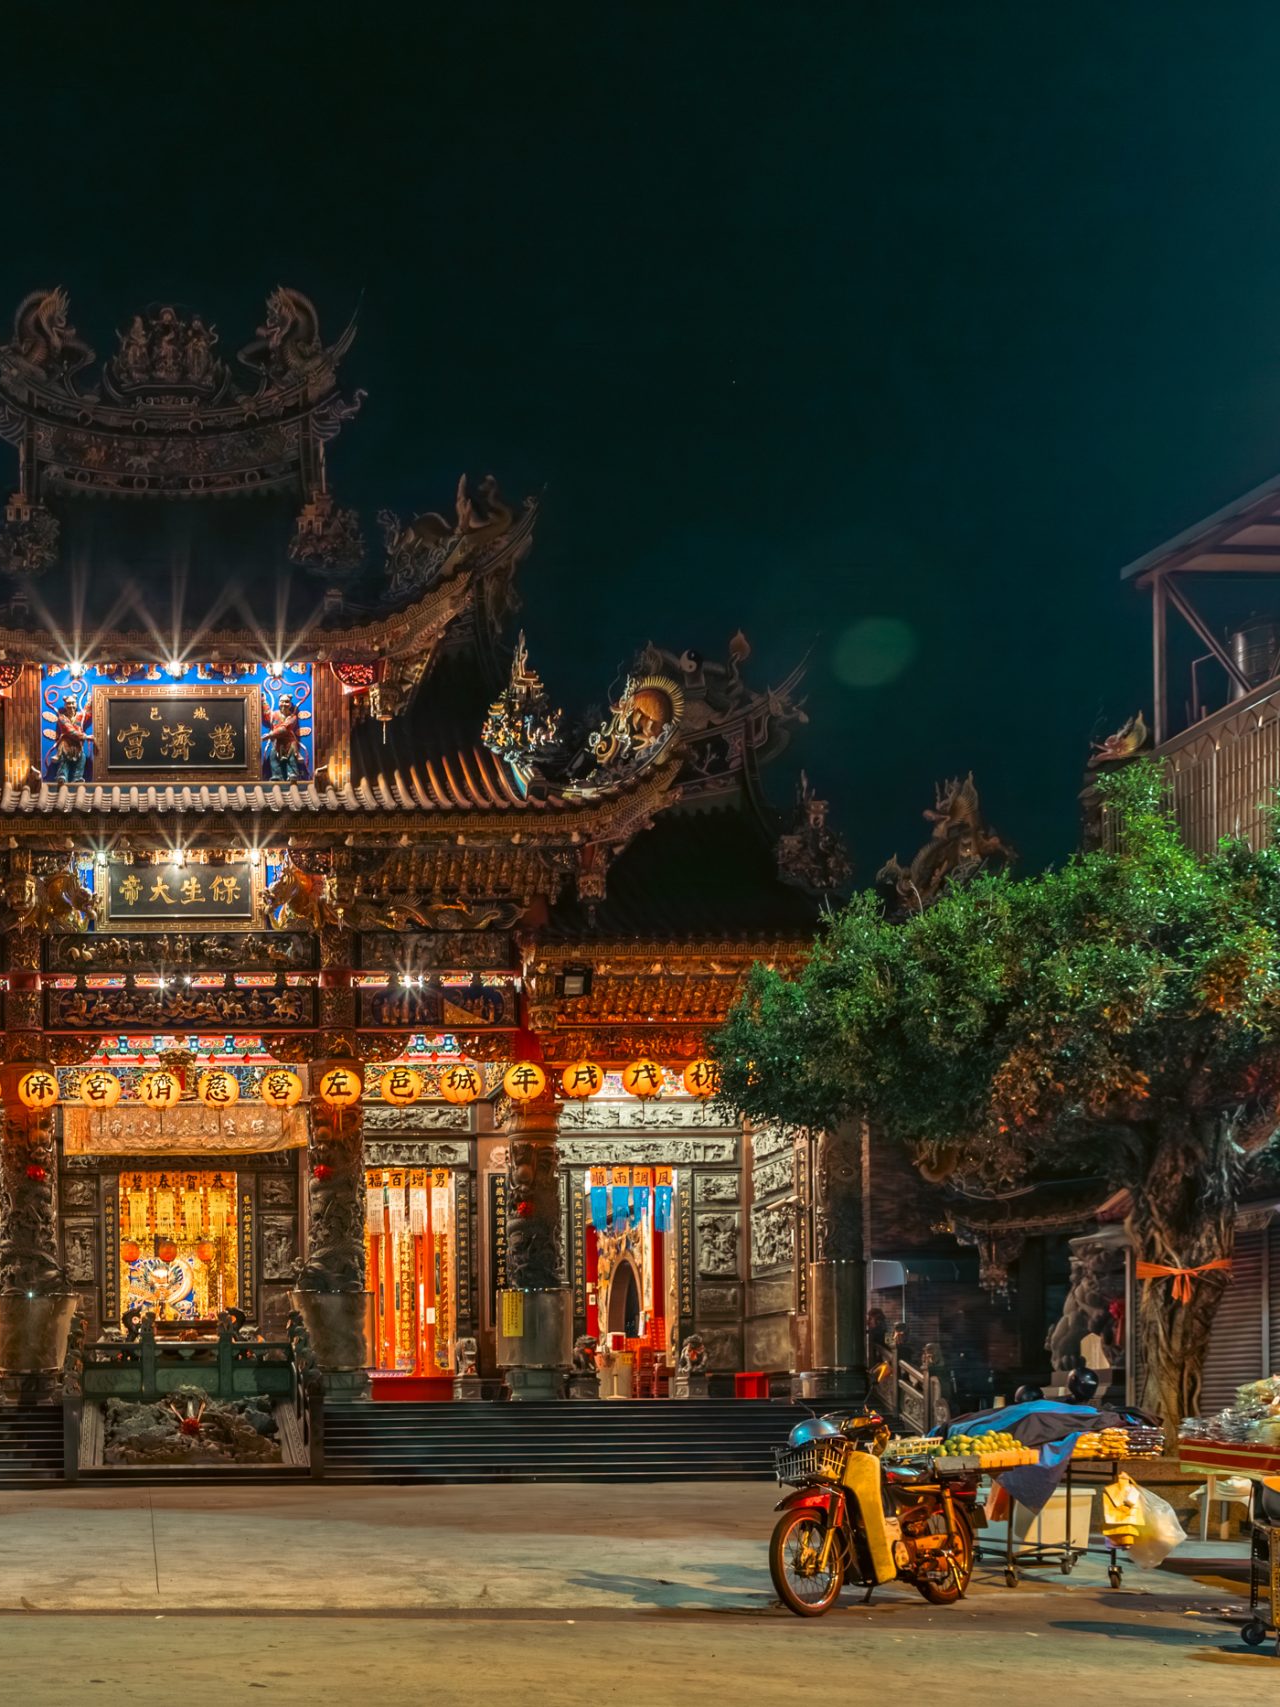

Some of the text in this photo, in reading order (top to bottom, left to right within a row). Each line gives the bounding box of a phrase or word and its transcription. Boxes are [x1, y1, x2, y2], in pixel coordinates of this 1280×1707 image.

[150, 706, 209, 721] 城邑
[117, 723, 237, 761] 慈濟宮
[119, 875, 241, 905] 保生大帝
